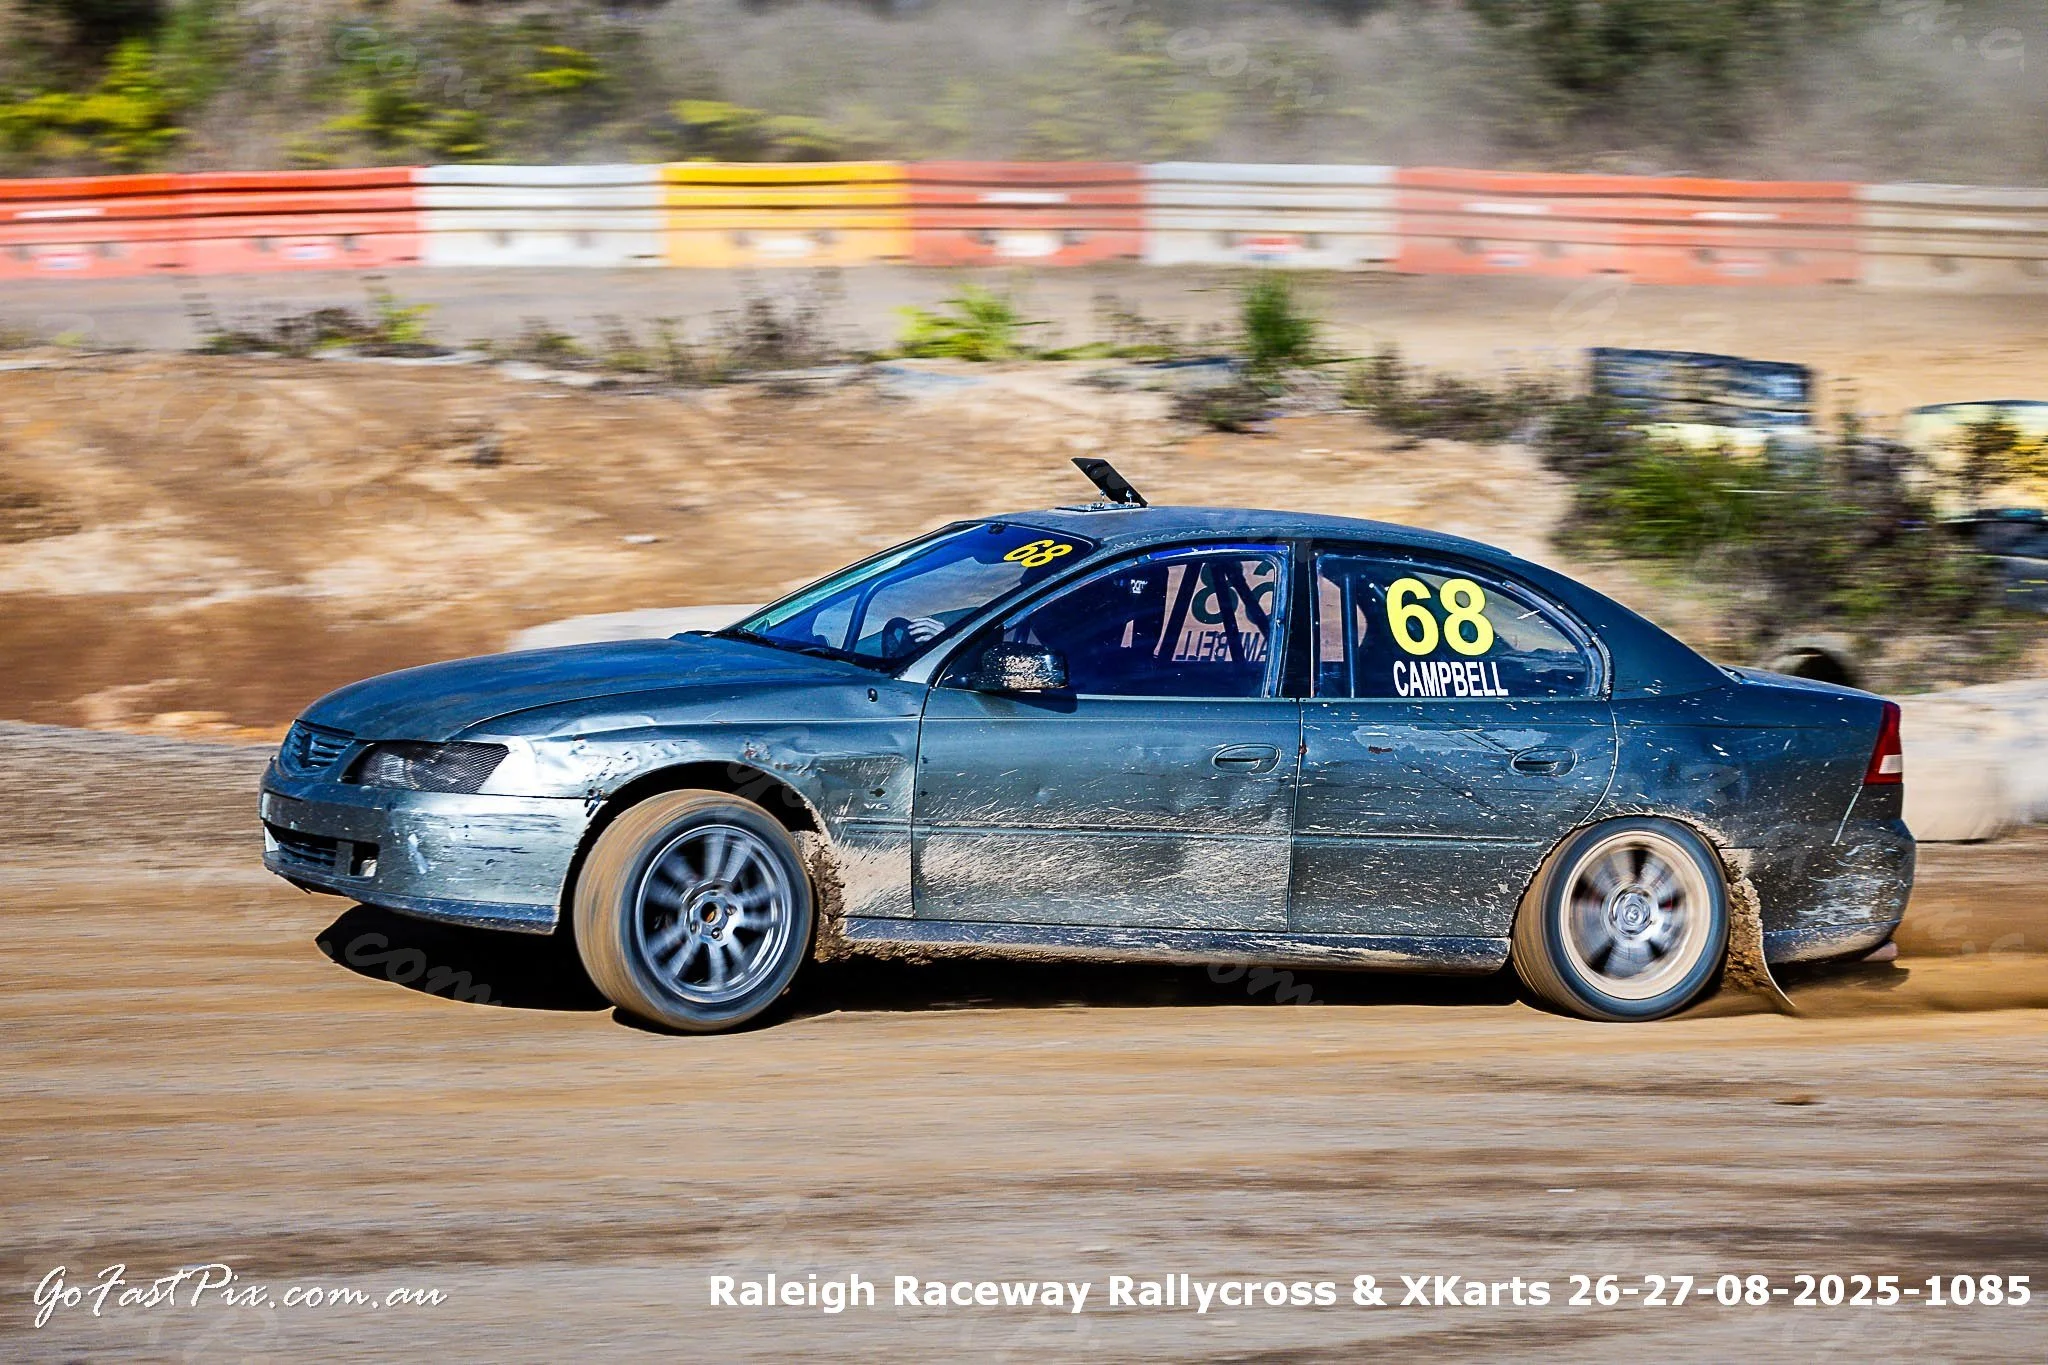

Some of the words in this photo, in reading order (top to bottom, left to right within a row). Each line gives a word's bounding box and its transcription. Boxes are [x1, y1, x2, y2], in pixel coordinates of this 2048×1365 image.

[1003, 539, 1073, 568] 68
[1386, 577, 1494, 656] 68
[1393, 660, 1509, 697] CAMPBELL
